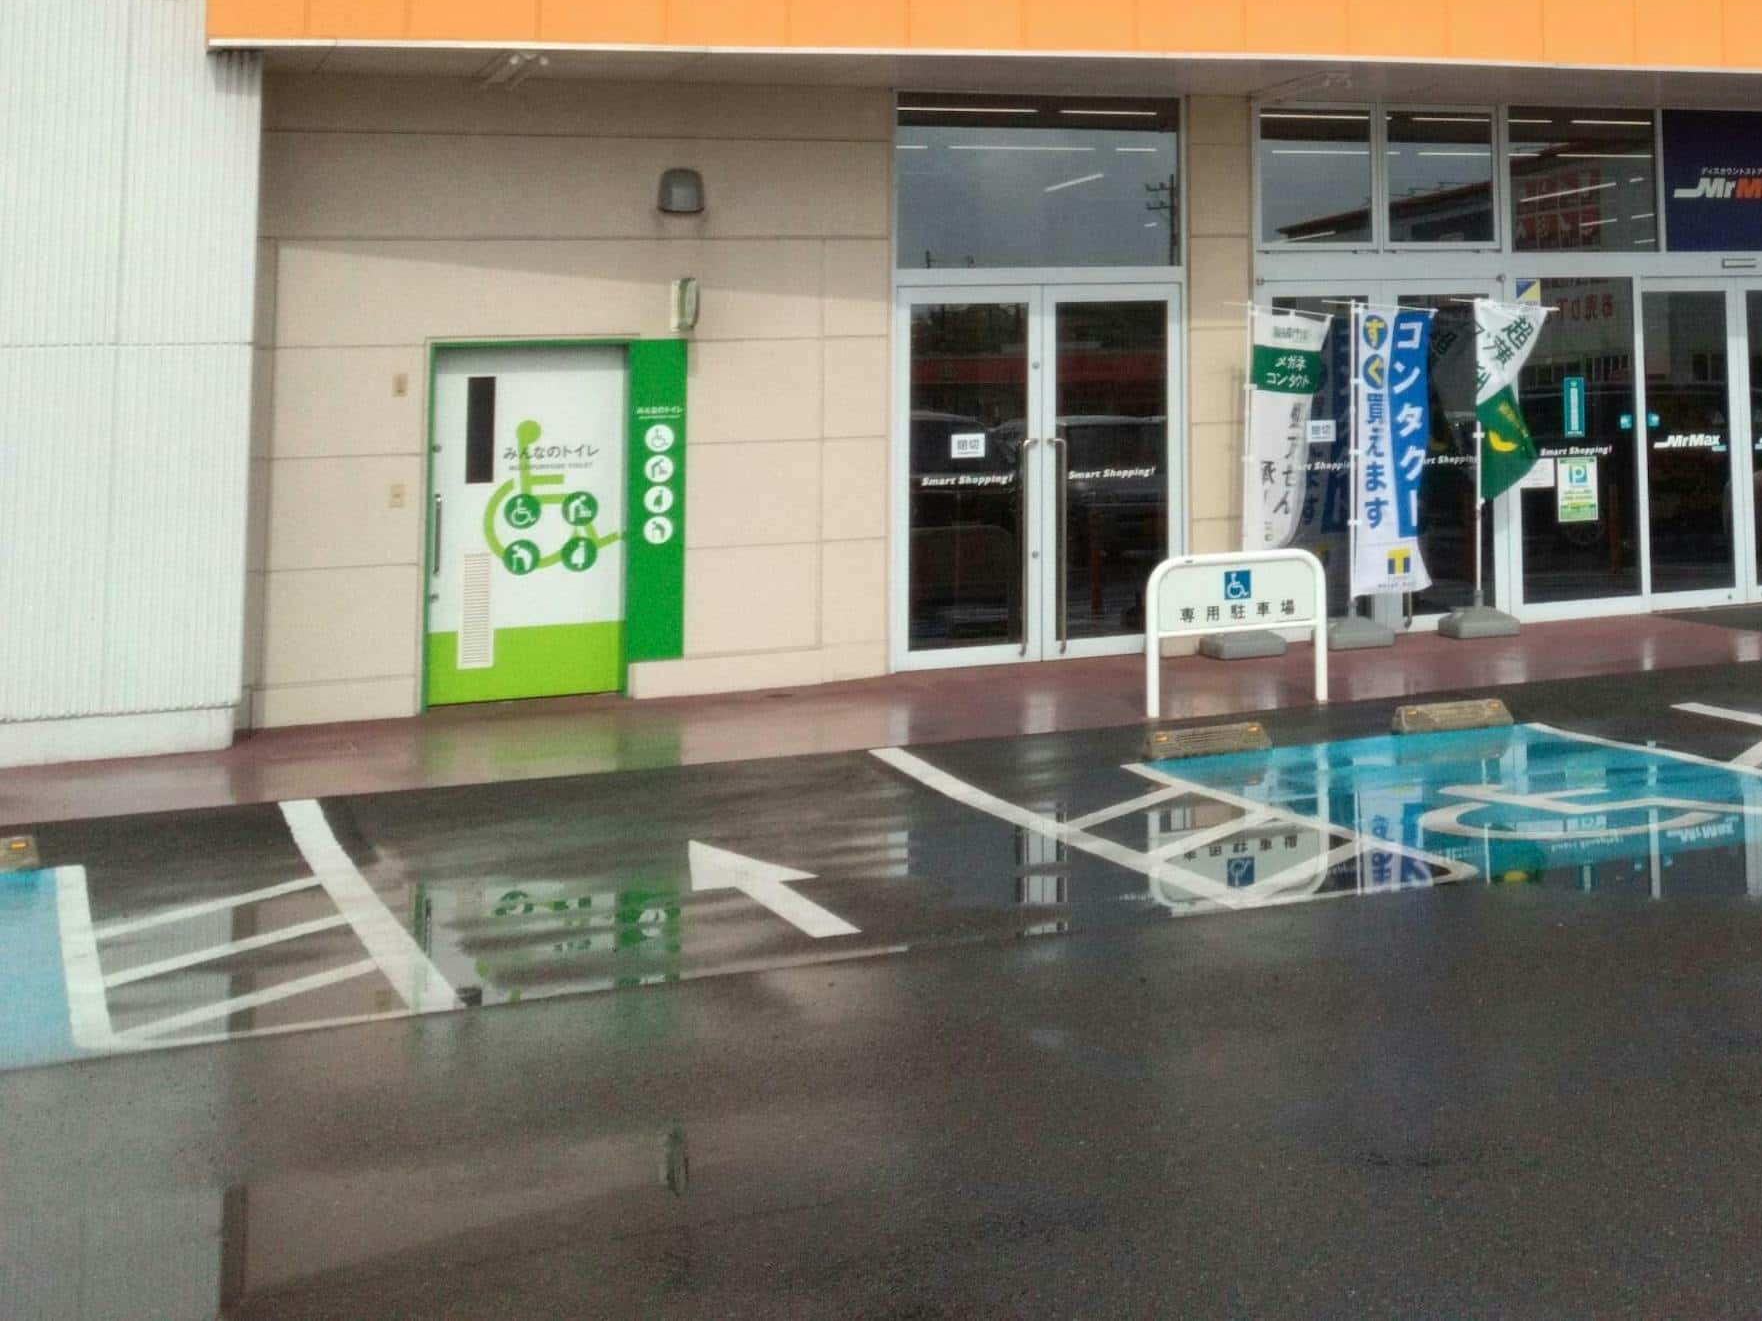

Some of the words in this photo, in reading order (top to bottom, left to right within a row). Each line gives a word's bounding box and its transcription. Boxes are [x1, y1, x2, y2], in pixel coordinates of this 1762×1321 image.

[503, 444, 600, 461] みんなのトイレ
[921, 475, 956, 487] Smart
[958, 473, 1014, 486] Shopping!
[1068, 468, 1102, 480] Smart
[1103, 466, 1156, 479] Shopping!
[1179, 598, 1296, 623] 専用駐車場
